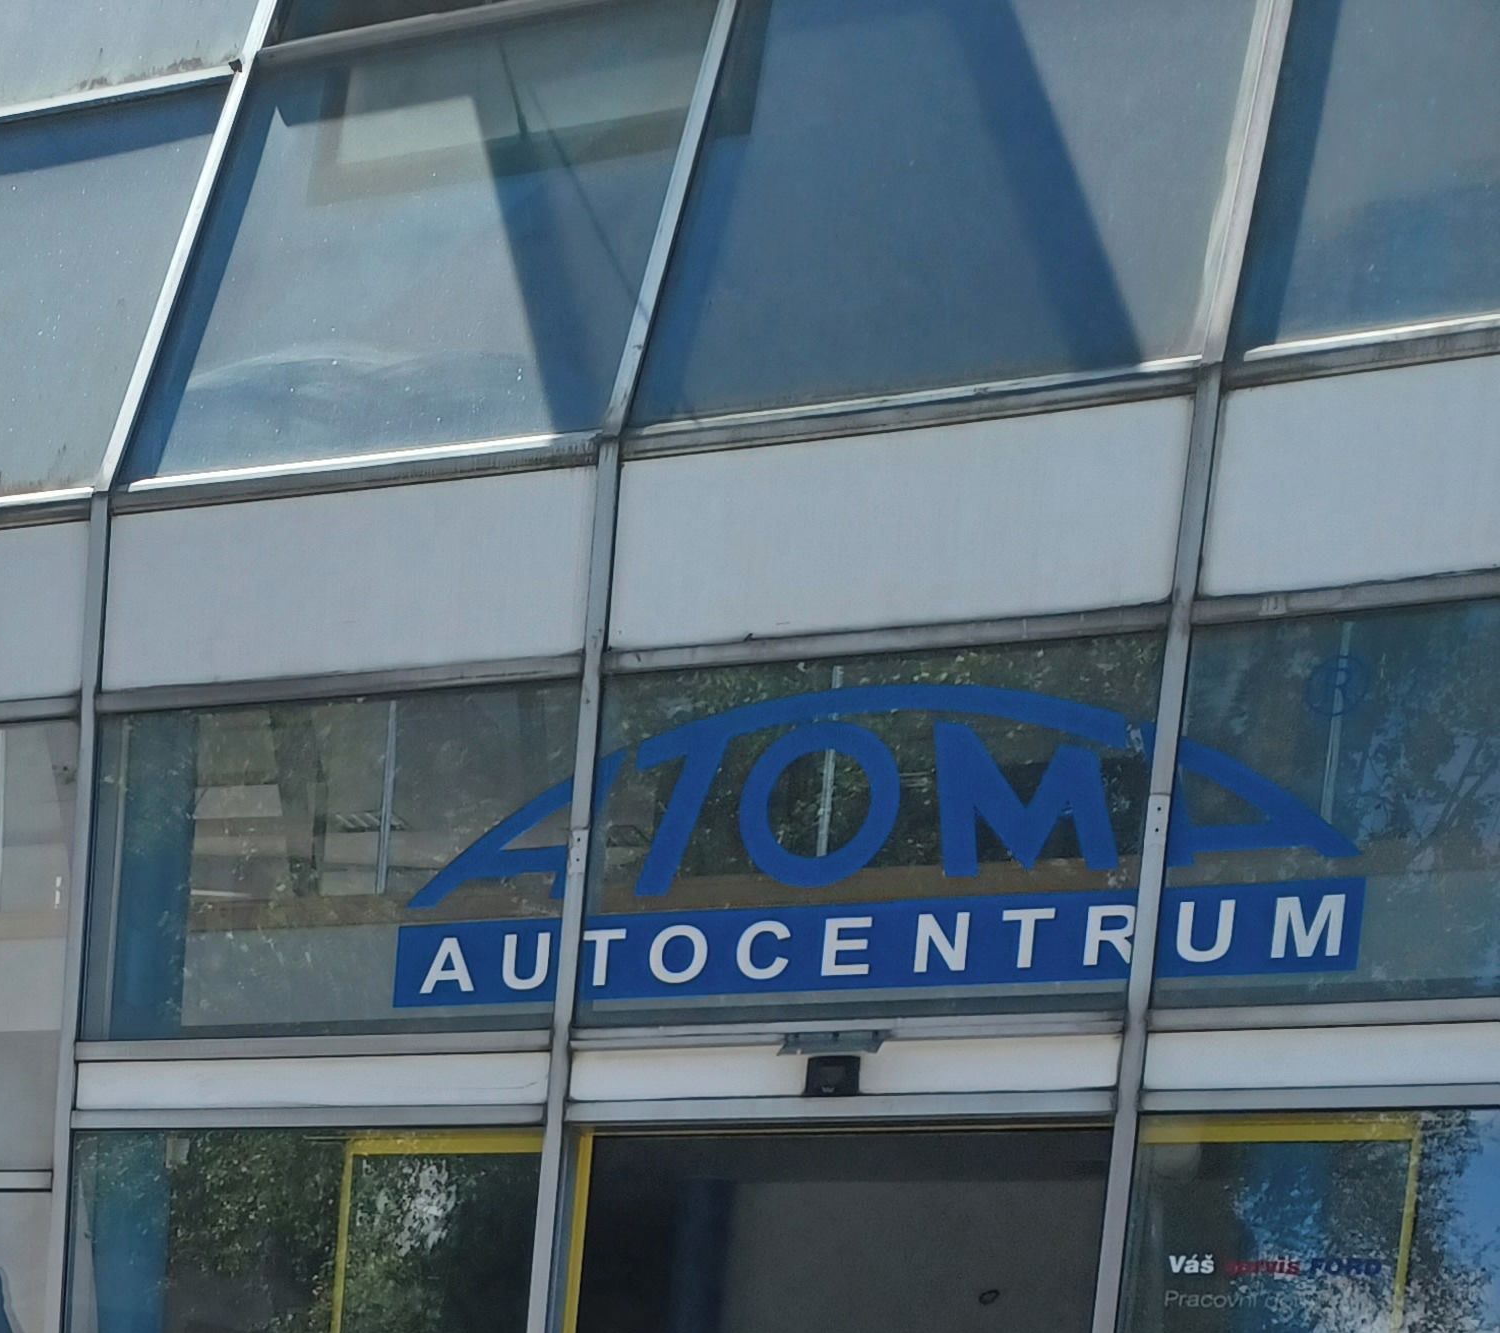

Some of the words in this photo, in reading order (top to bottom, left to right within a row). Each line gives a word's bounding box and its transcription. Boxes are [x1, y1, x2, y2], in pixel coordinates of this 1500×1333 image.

[407, 684, 1363, 909] ATOMA
[419, 893, 1347, 995] AUTOCENTRUM
[1168, 1254, 1215, 1274] Váš
